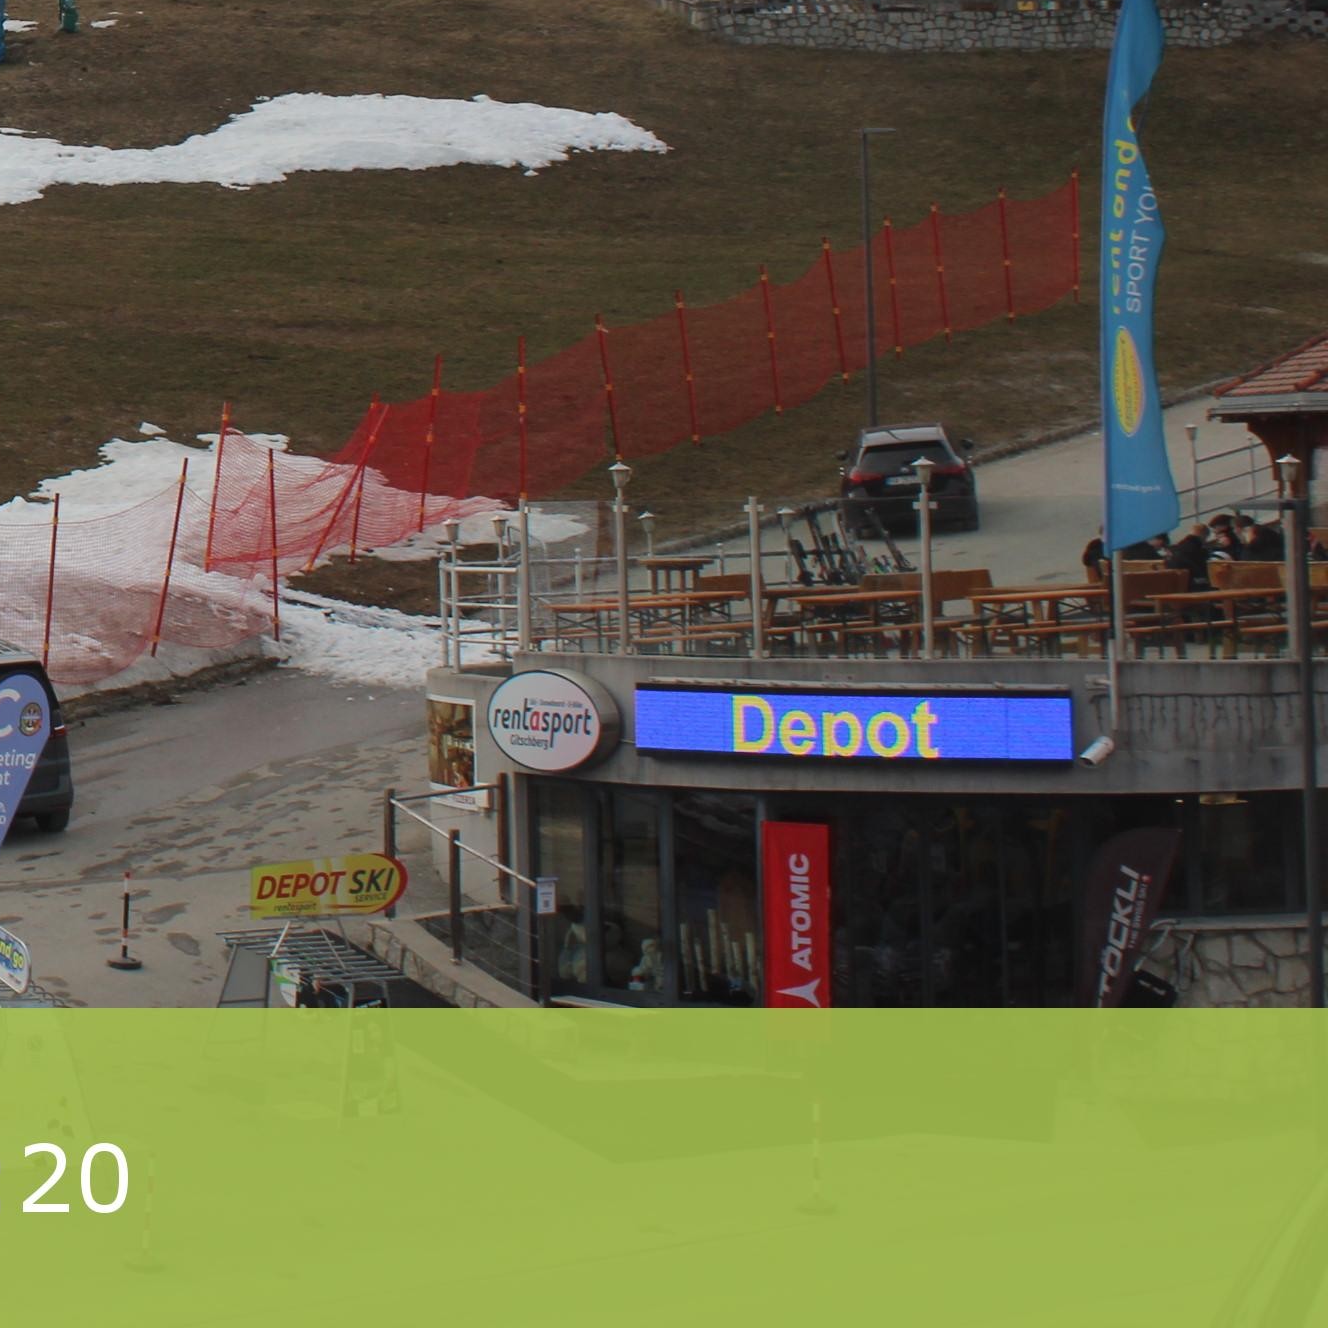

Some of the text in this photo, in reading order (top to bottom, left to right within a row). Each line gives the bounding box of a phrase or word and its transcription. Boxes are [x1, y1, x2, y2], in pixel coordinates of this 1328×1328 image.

[1112, 138, 1138, 219] and
[1126, 230, 1152, 313] SPORT
[493, 698, 593, 749] rentasport
[510, 734, 549, 750] Gitschberg
[732, 695, 939, 759] Depot
[256, 867, 395, 900] DEPOT SKI
[789, 853, 814, 972] ATOMIC
[11, 950, 25, 969] go
